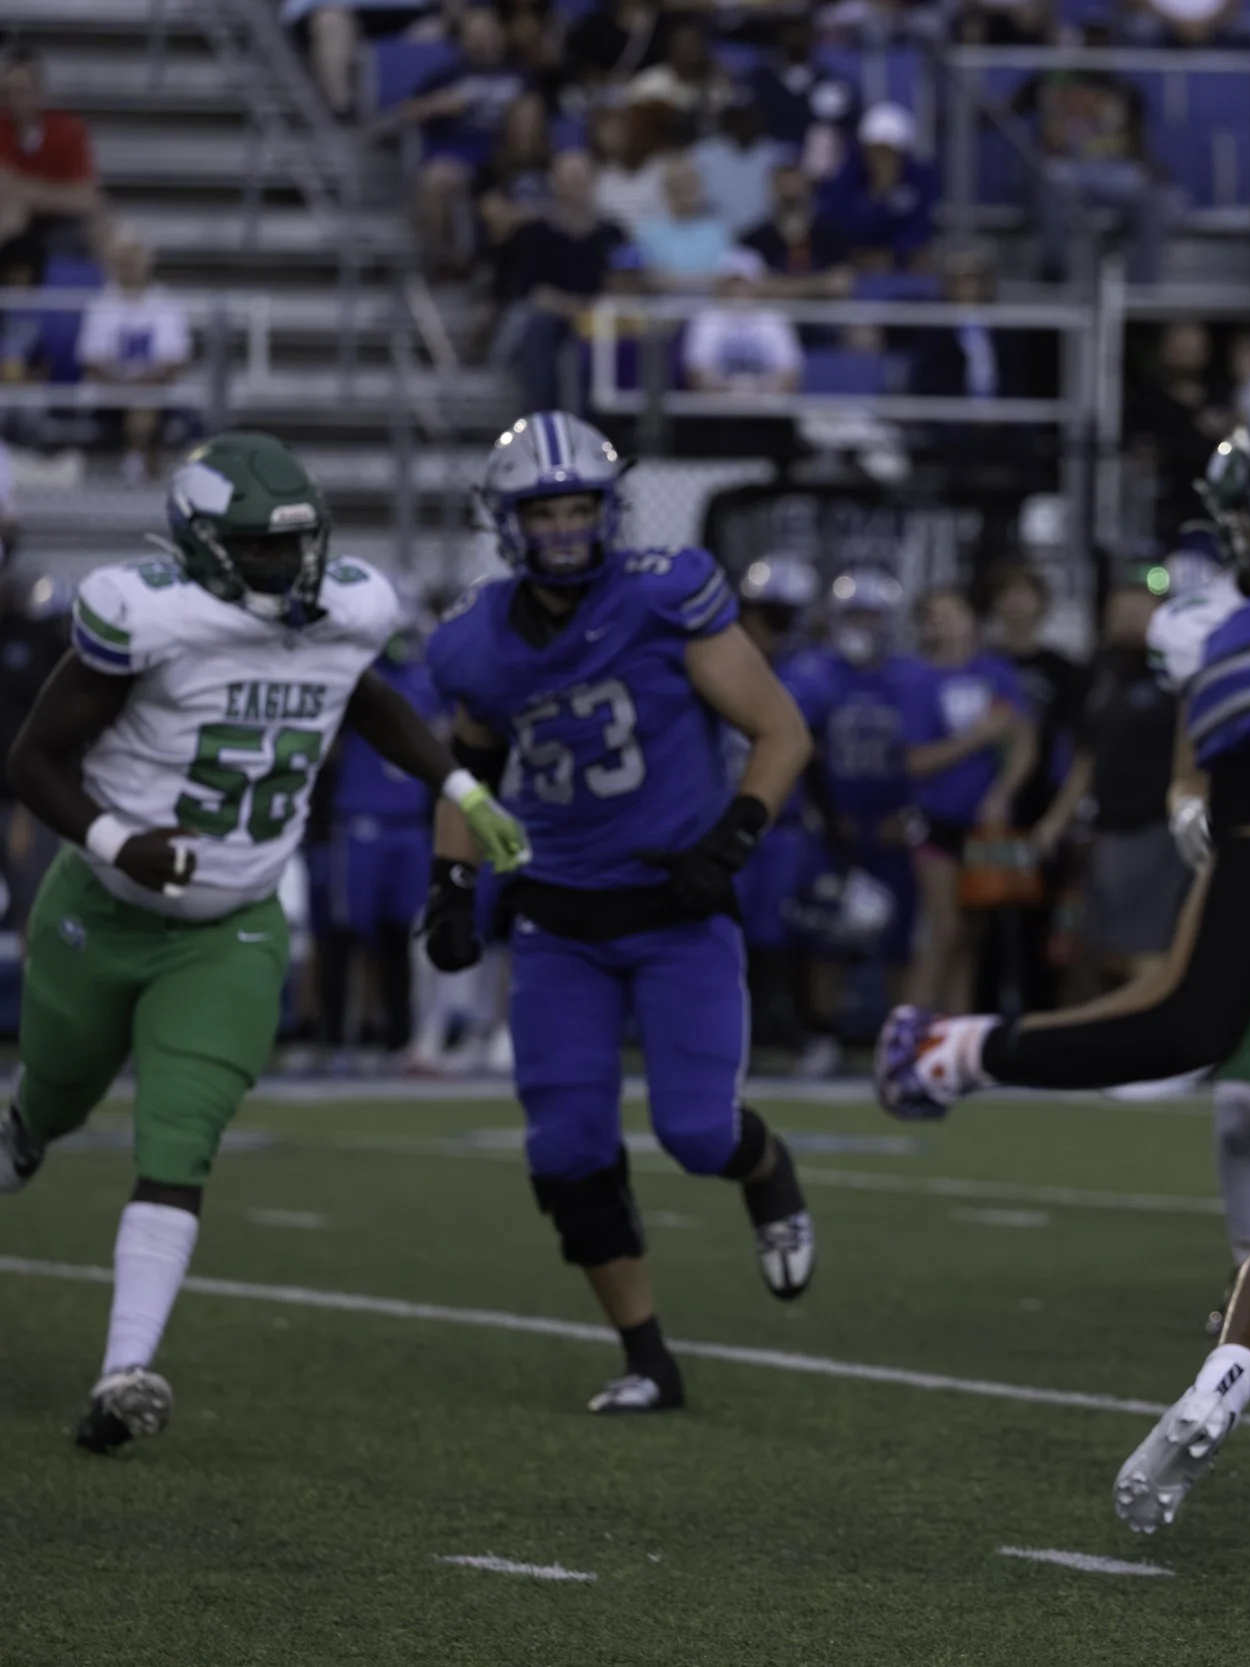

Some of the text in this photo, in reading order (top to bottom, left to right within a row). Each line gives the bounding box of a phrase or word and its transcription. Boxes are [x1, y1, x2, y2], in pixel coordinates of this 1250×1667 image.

[225, 682, 327, 720] EAGLES
[508, 676, 646, 806] 53
[174, 722, 323, 843] 56
